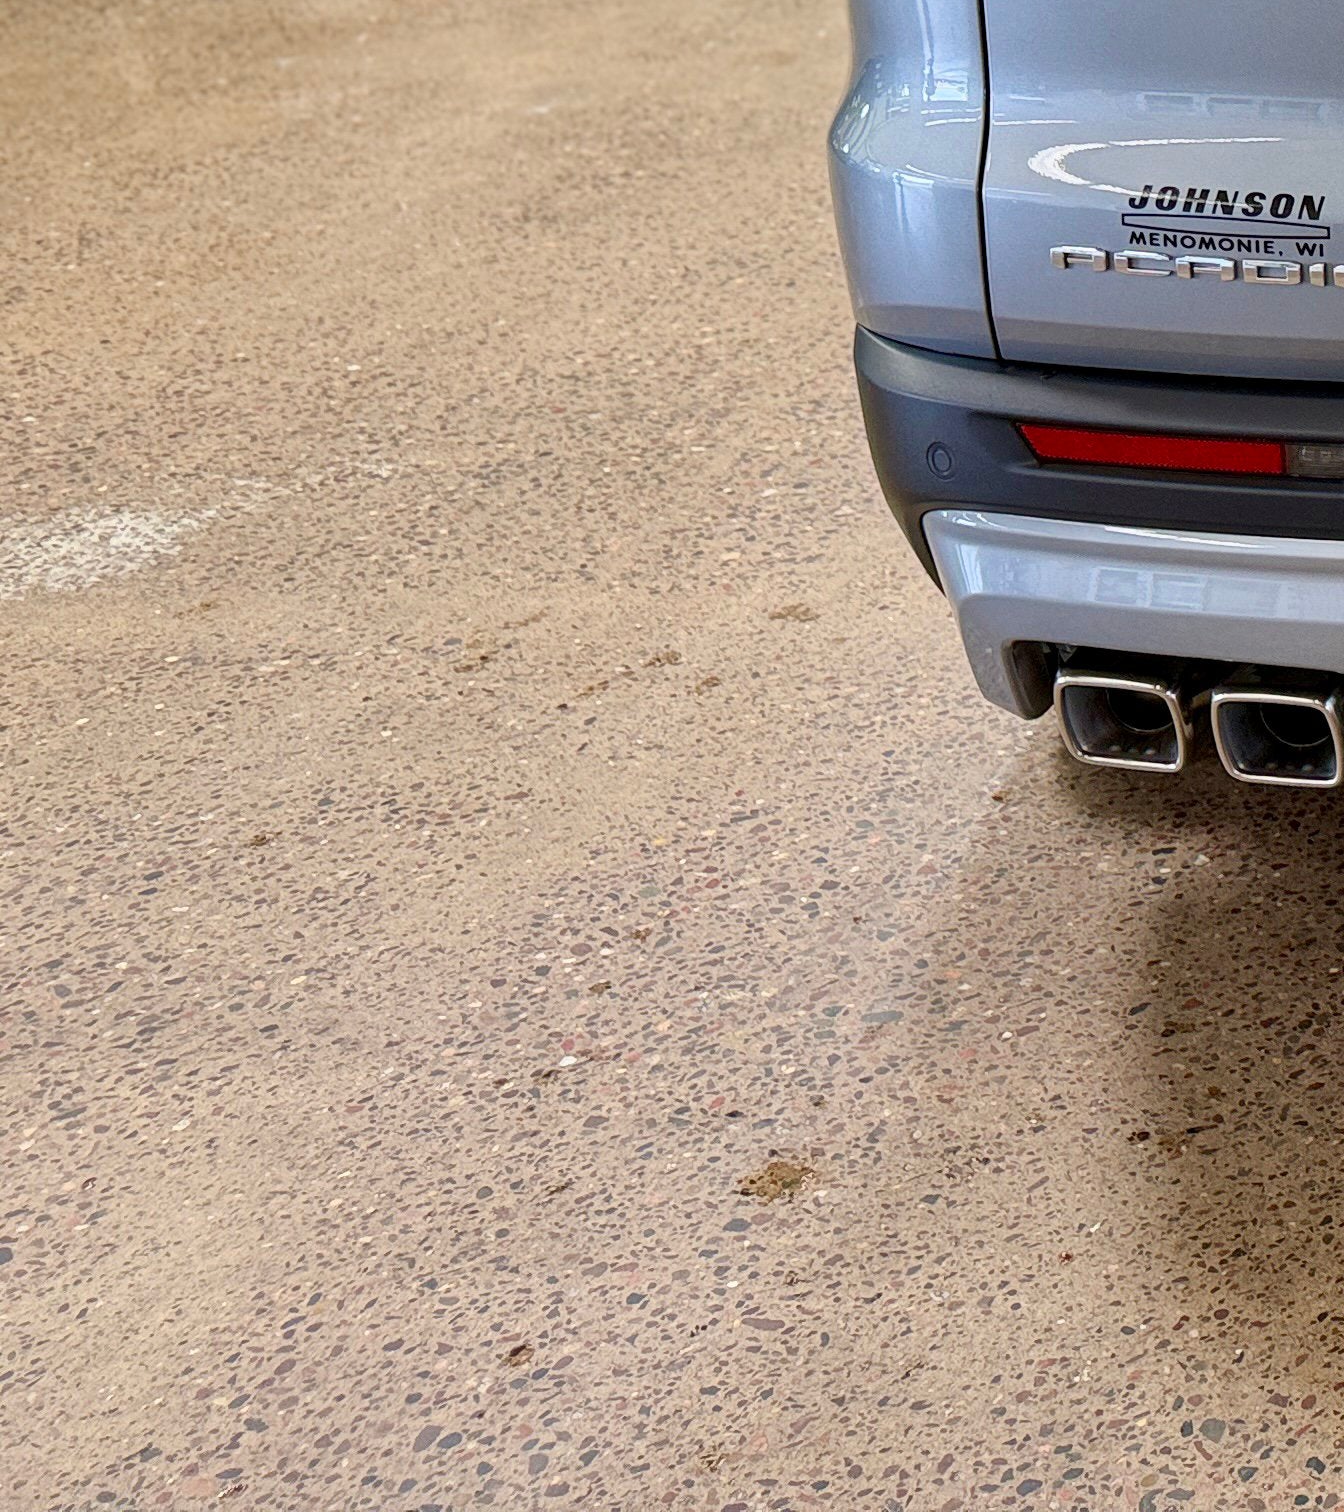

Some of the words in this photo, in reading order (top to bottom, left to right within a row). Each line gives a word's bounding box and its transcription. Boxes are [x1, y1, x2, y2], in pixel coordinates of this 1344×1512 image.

[1128, 185, 1326, 221] JOHNSON
[1129, 231, 1284, 257] MENOMONIE,
[1295, 242, 1325, 257] WI
